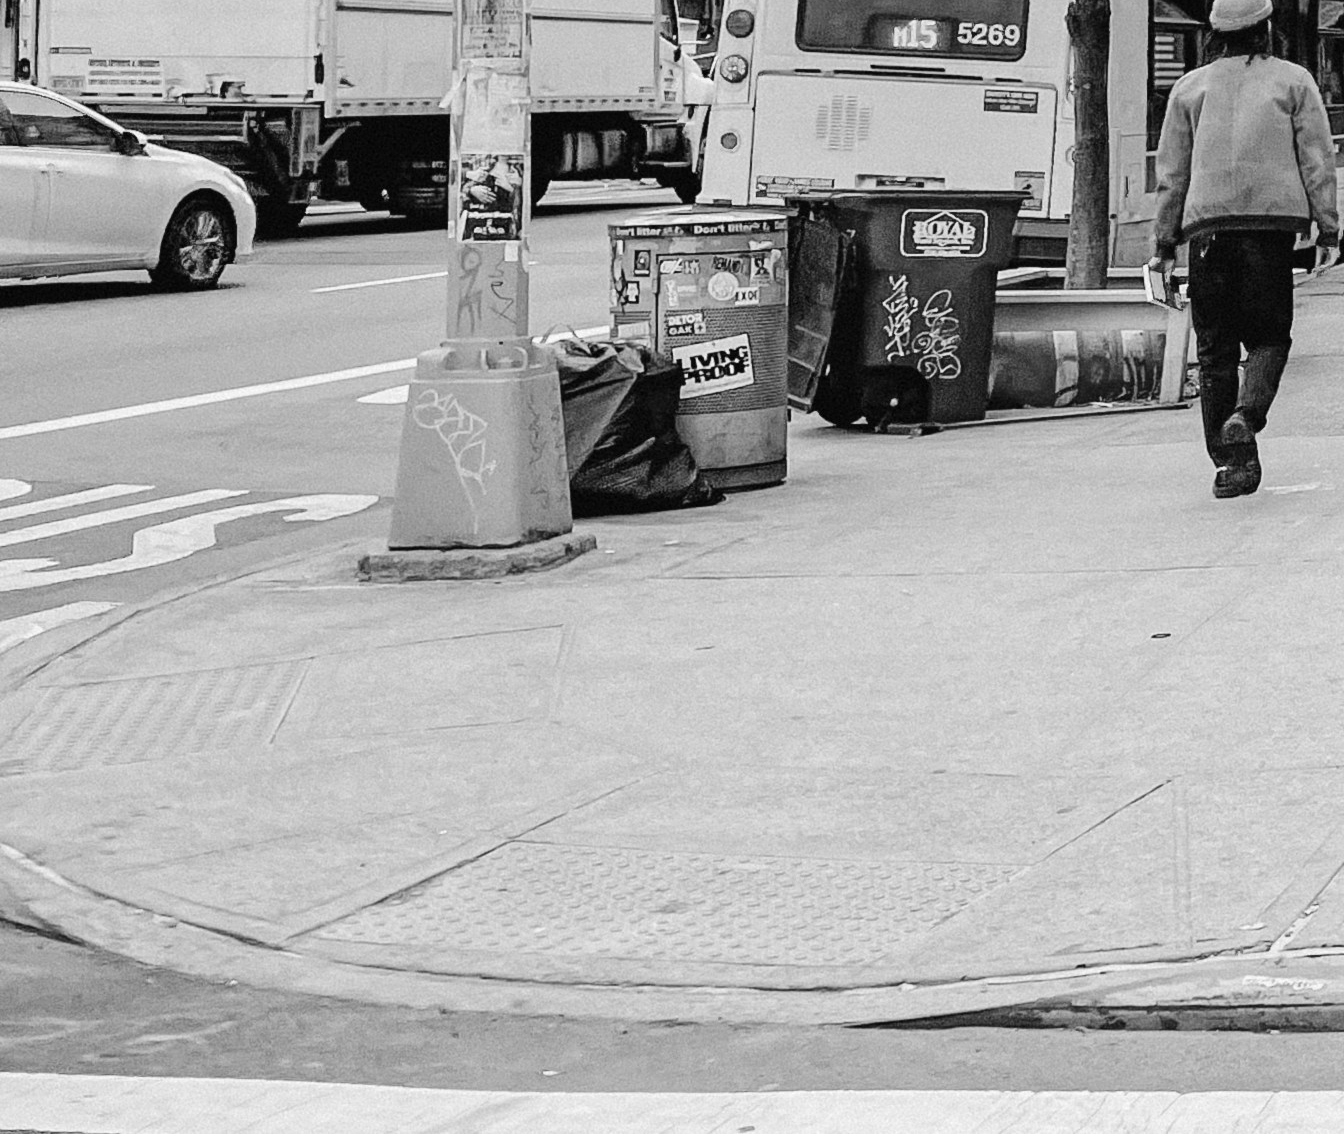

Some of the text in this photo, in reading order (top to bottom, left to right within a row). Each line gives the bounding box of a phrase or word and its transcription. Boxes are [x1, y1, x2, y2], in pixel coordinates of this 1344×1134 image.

[956, 22, 1021, 47] 5269
[693, 224, 725, 235] Don't
[912, 220, 976, 239] ROYAL
